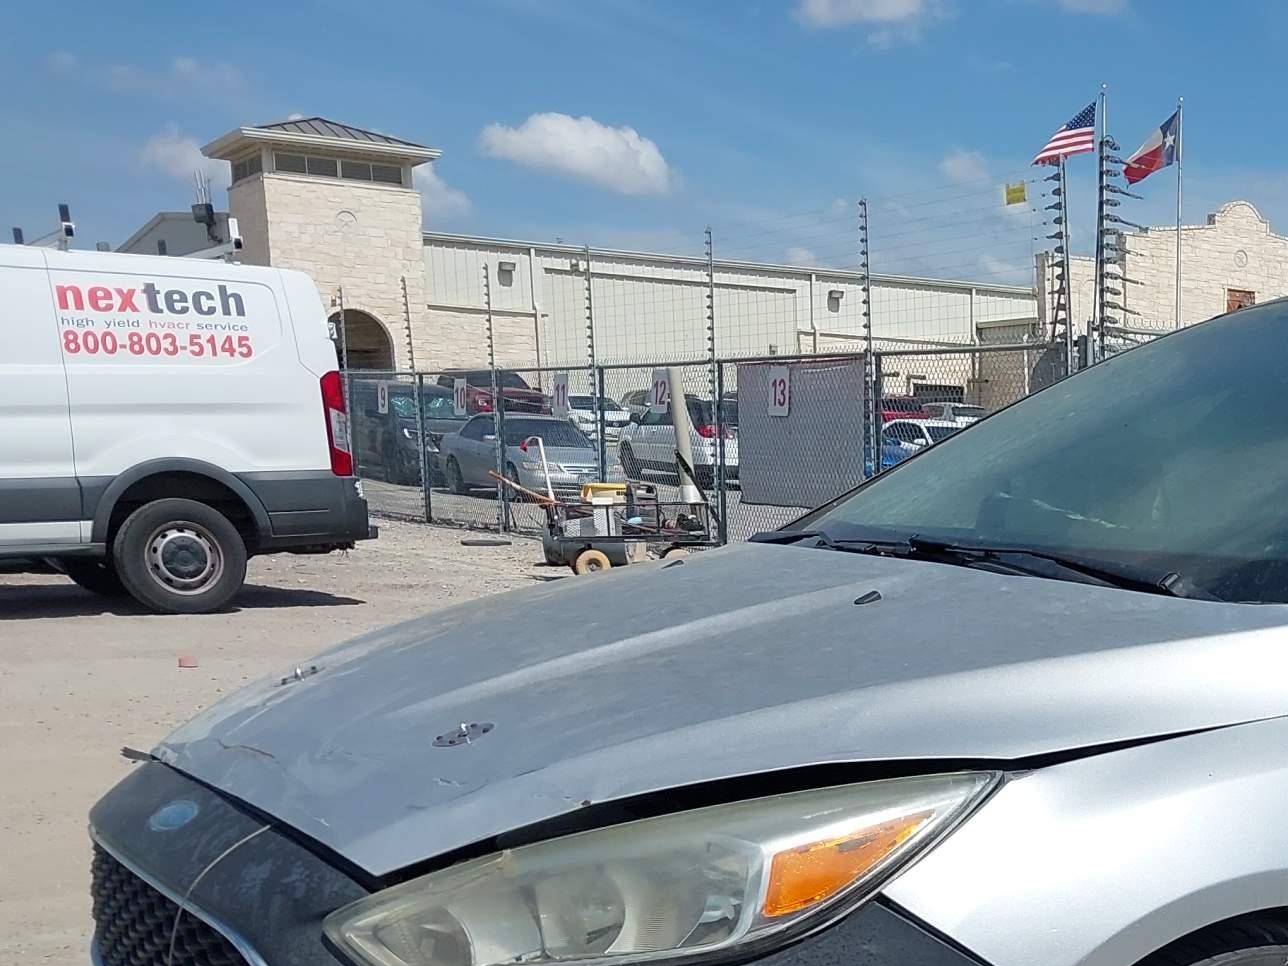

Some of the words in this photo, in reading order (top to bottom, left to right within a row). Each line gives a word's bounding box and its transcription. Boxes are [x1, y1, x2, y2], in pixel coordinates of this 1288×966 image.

[56, 283, 246, 317] nextech
[61, 317, 95, 329] high
[104, 318, 140, 329] yield
[149, 319, 191, 330] hvacr
[196, 320, 249, 331] service
[63, 329, 253, 359] 800-803-5145
[380, 386, 386, 409] 9
[455, 387, 465, 409] 10
[555, 383, 565, 406] 11
[653, 380, 666, 405] 12
[772, 378, 786, 407] 13
